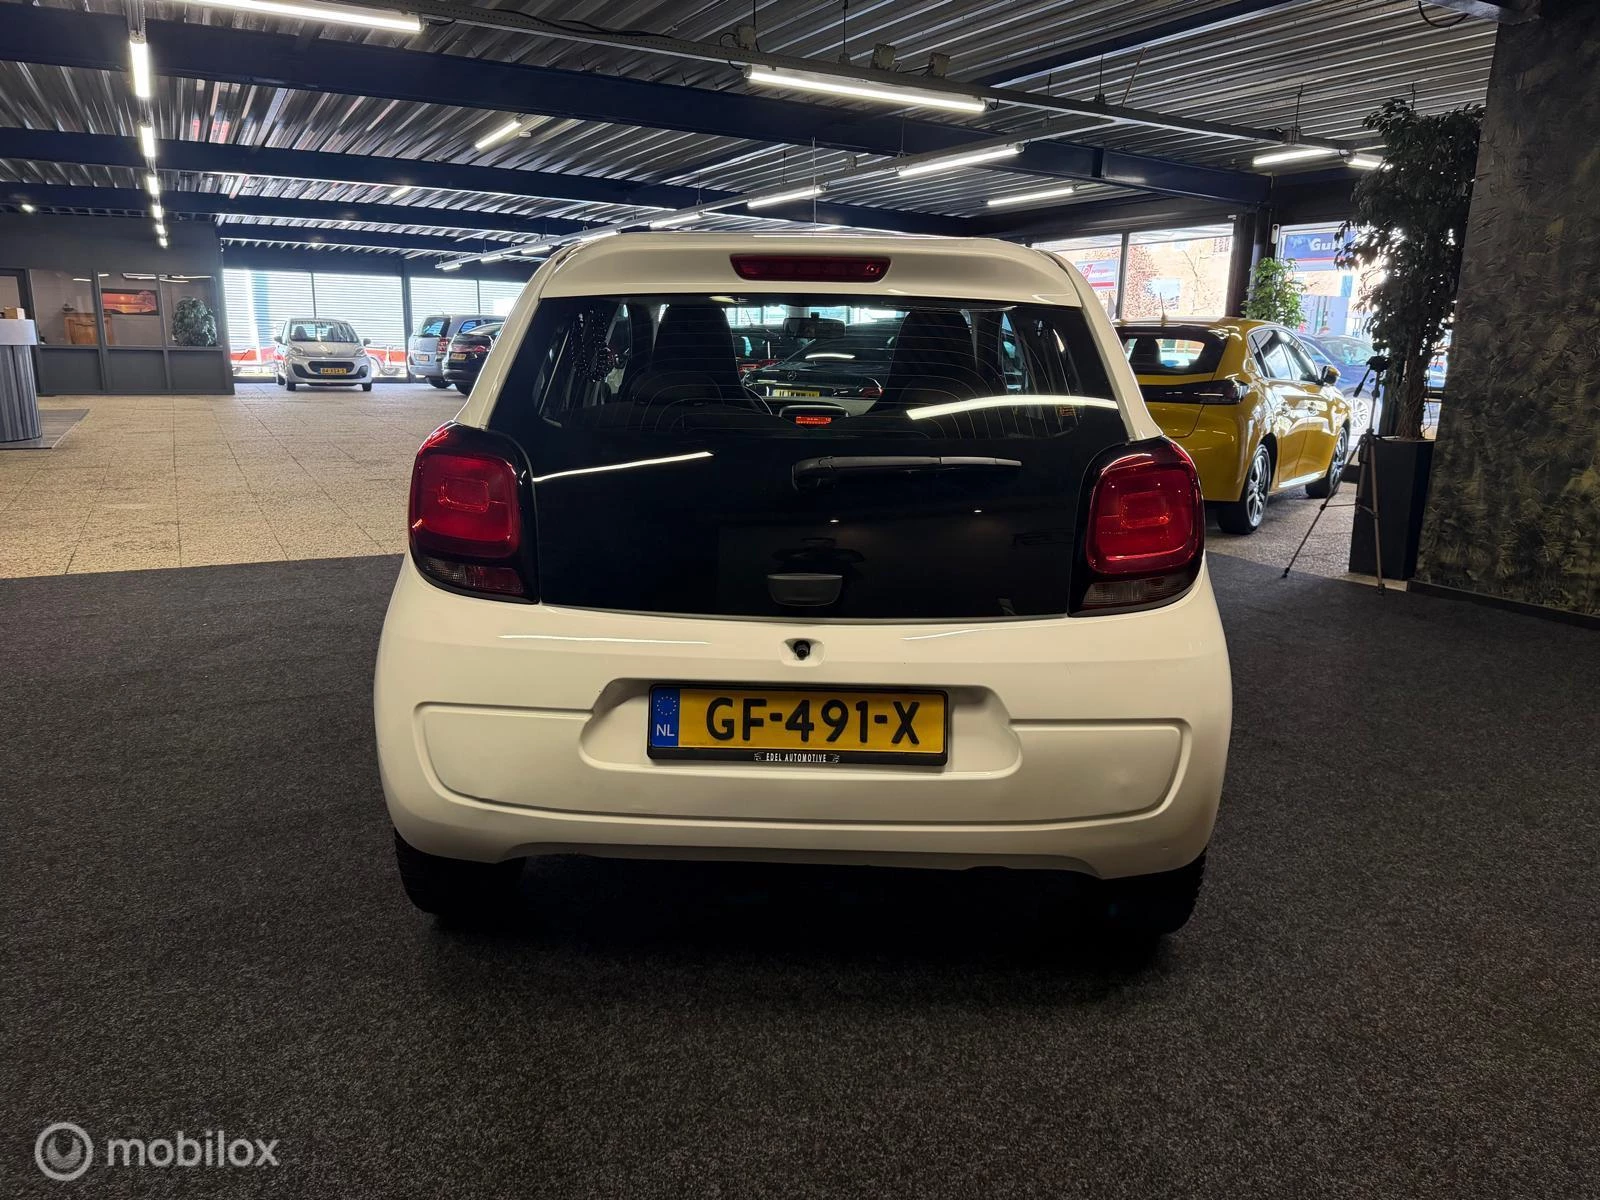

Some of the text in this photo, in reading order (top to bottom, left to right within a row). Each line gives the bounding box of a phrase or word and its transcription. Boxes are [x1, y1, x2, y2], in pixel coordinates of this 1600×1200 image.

[706, 697, 920, 745] GF-491-X
[656, 724, 675, 737] NL
[766, 752, 827, 763] EDEL AUTOMOTIVE
